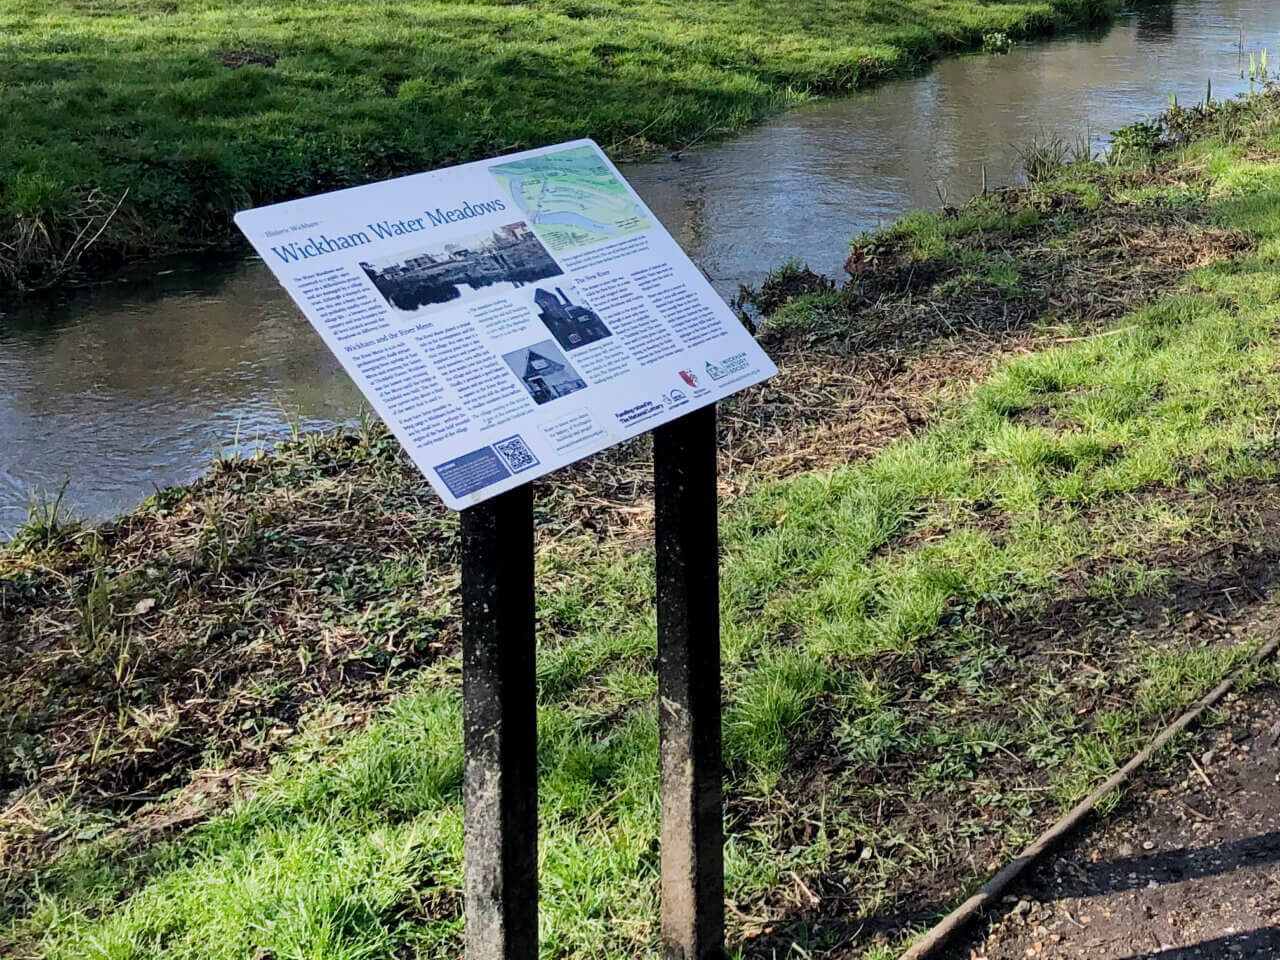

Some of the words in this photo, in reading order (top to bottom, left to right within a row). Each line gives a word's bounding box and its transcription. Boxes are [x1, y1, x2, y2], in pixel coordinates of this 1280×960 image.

[270, 234, 371, 264] Wickham
[367, 217, 426, 240] Water
[424, 199, 506, 227] Meadows
